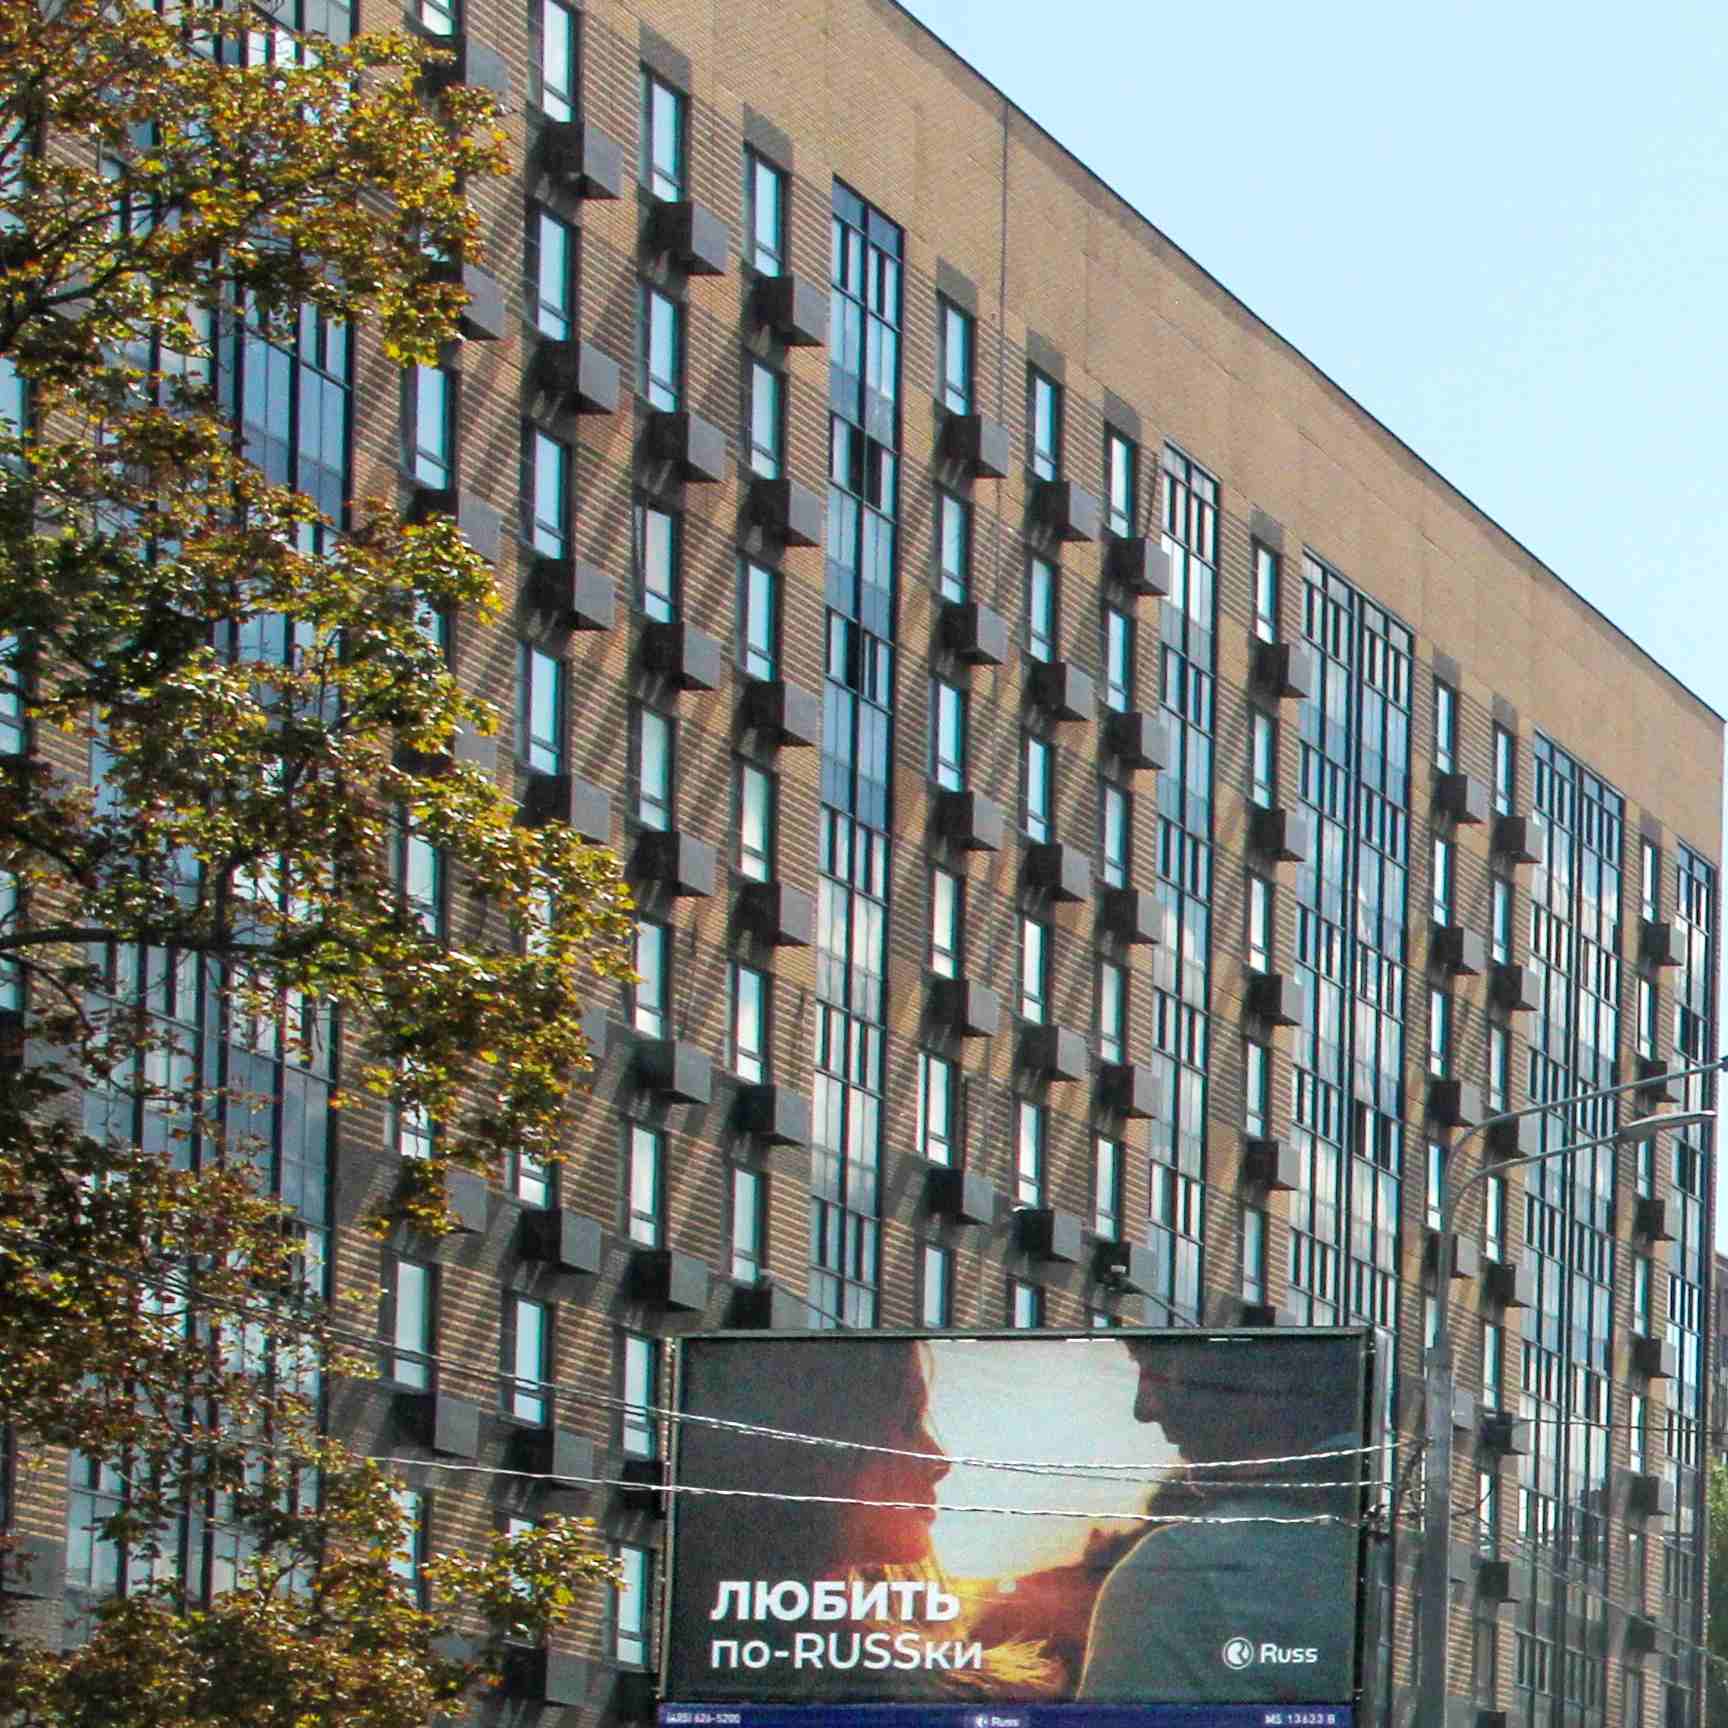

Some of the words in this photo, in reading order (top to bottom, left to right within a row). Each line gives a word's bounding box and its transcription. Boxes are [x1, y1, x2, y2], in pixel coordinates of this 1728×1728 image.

[709, 1580, 960, 1622] ЛЮБИТЬ
[711, 1632, 983, 1669] по-RUSSки
[1260, 1643, 1319, 1664] Russ
